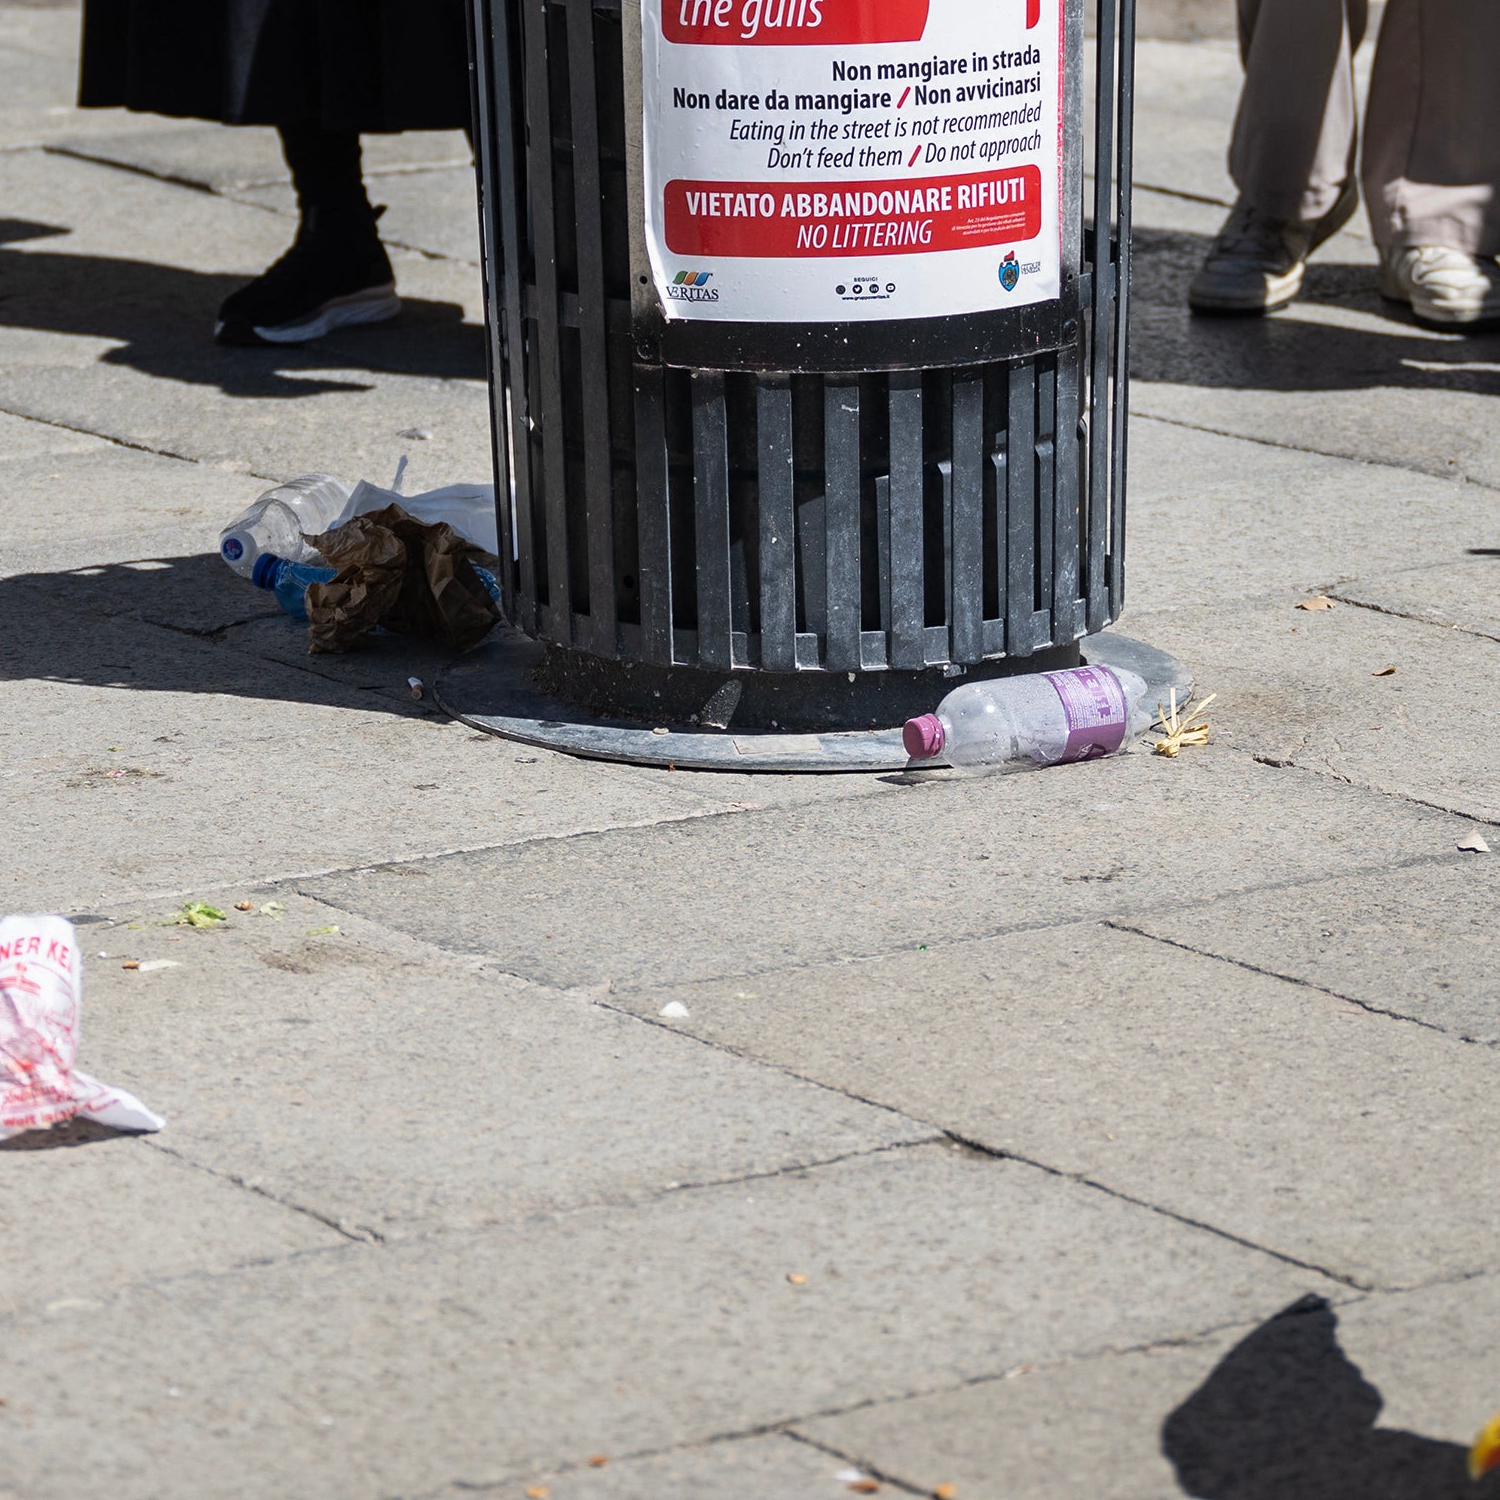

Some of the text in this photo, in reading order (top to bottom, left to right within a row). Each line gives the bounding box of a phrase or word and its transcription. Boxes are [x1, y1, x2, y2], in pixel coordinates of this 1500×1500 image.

[832, 44, 1041, 83] Non mangiare in strada
[673, 87, 710, 109] Non
[715, 88, 760, 111] dare
[764, 88, 789, 111] da
[794, 88, 892, 115] mangiare
[914, 84, 951, 106] Non
[956, 71, 1041, 103] avvicinarsi
[729, 100, 1042, 146] Eating in the street is not recommended
[816, 146, 856, 169] feed
[858, 145, 903, 168] them
[925, 142, 947, 164] Do
[950, 140, 977, 161] not
[979, 129, 1042, 163] approach
[685, 177, 1026, 218] VIETATO ABBANDONARE RIFIUTI
[796, 219, 933, 249] NO LITTERING
[666, 286, 719, 303] VERITAS
